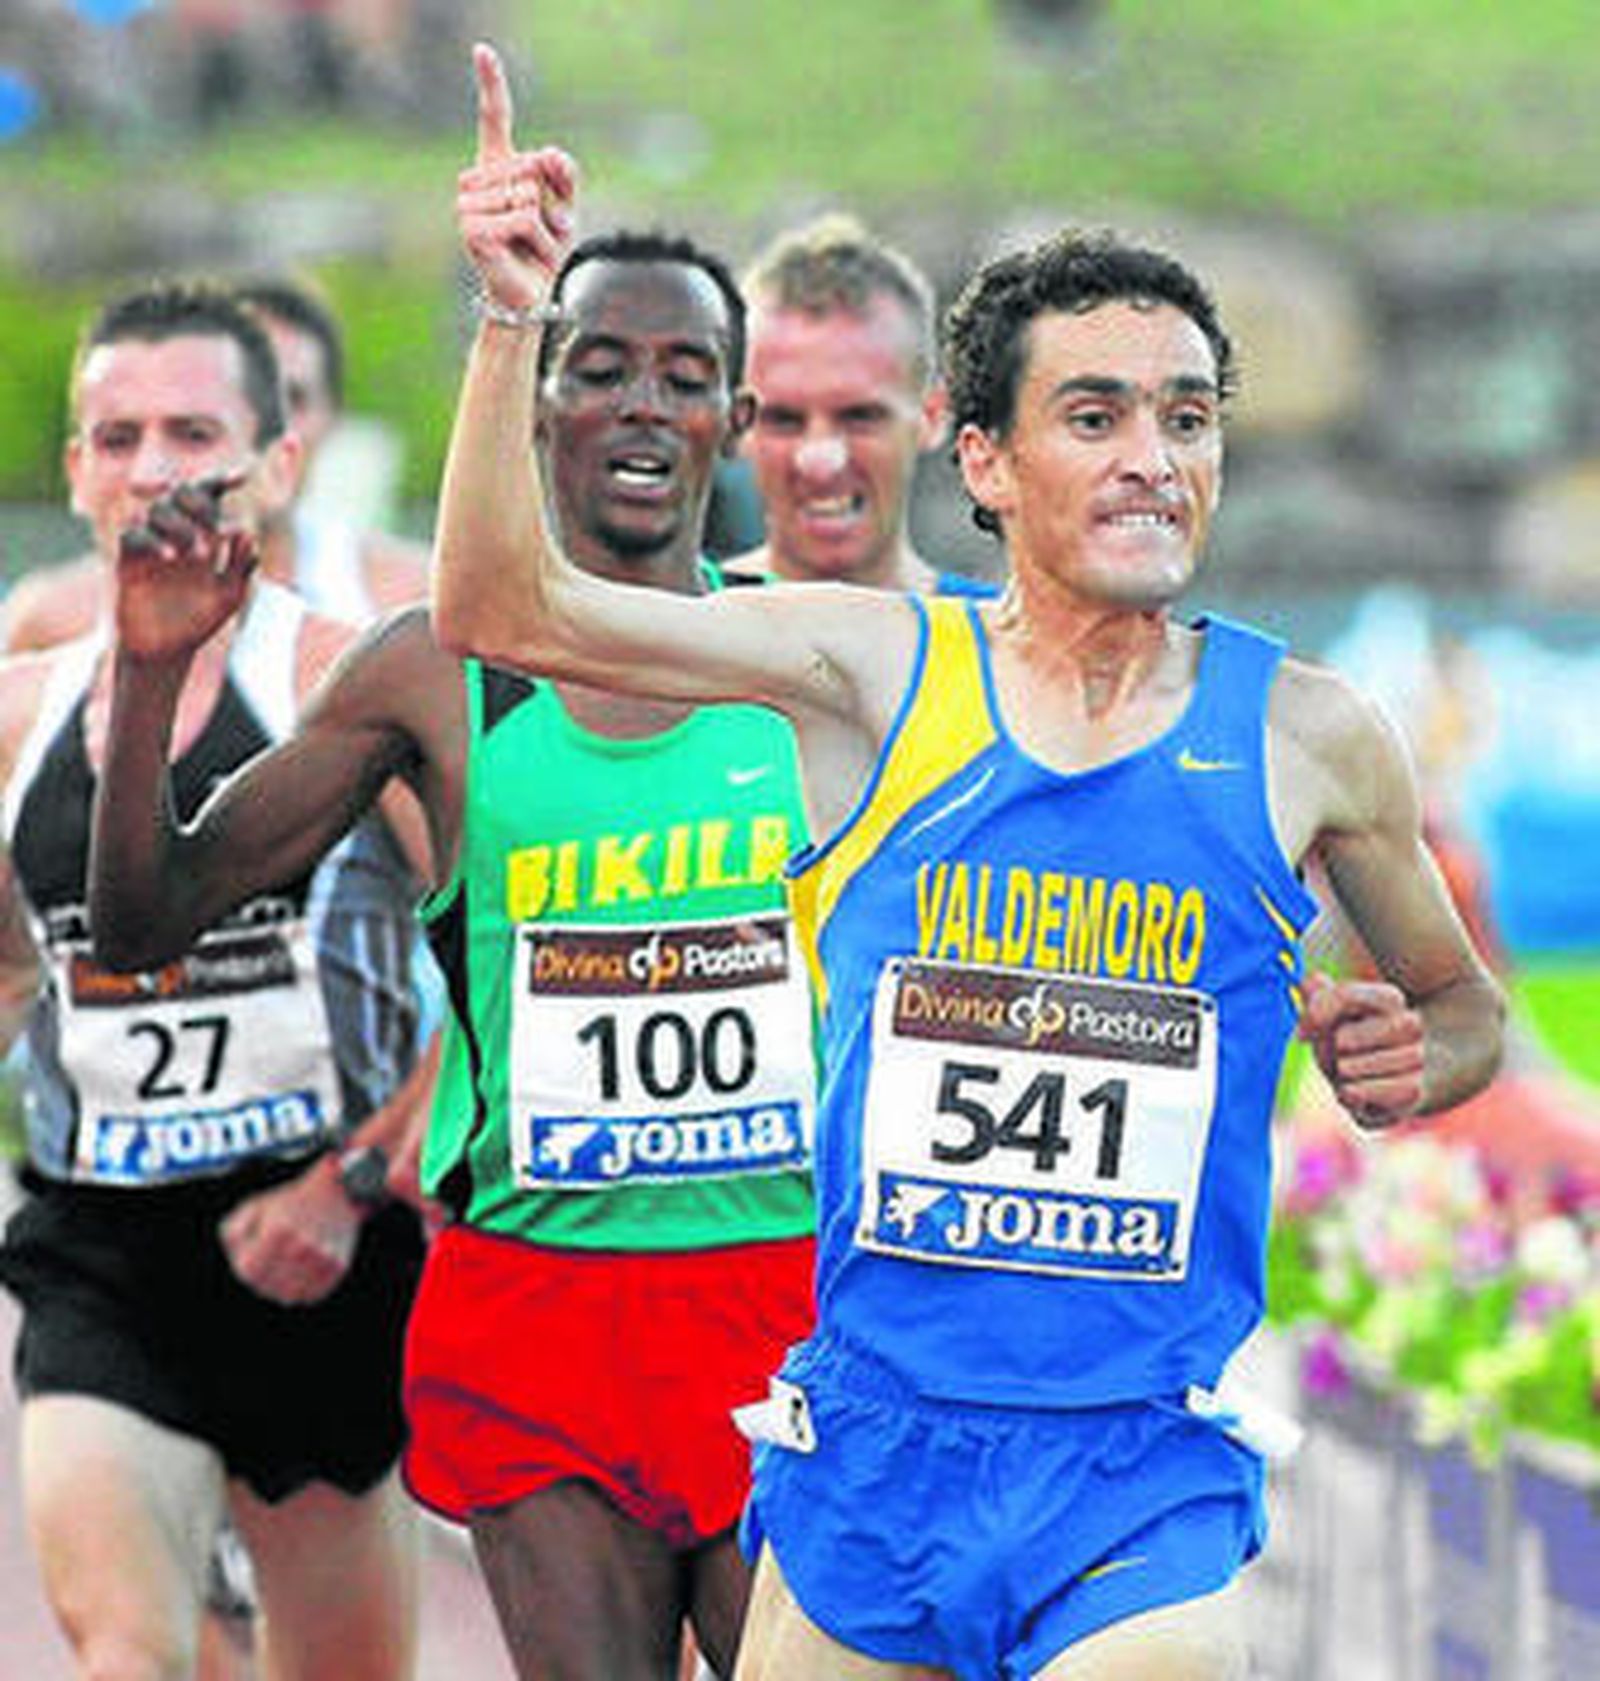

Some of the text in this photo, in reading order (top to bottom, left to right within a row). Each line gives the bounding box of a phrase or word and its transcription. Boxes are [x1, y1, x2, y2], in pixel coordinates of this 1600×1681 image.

[915, 863, 1206, 984] VALDEMORO
[128, 1016, 229, 1099] 27
[577, 1007, 756, 1102] 100
[901, 983, 1001, 1028] Divina
[1070, 1001, 1195, 1048] Pastora
[930, 1060, 1129, 1180] 541
